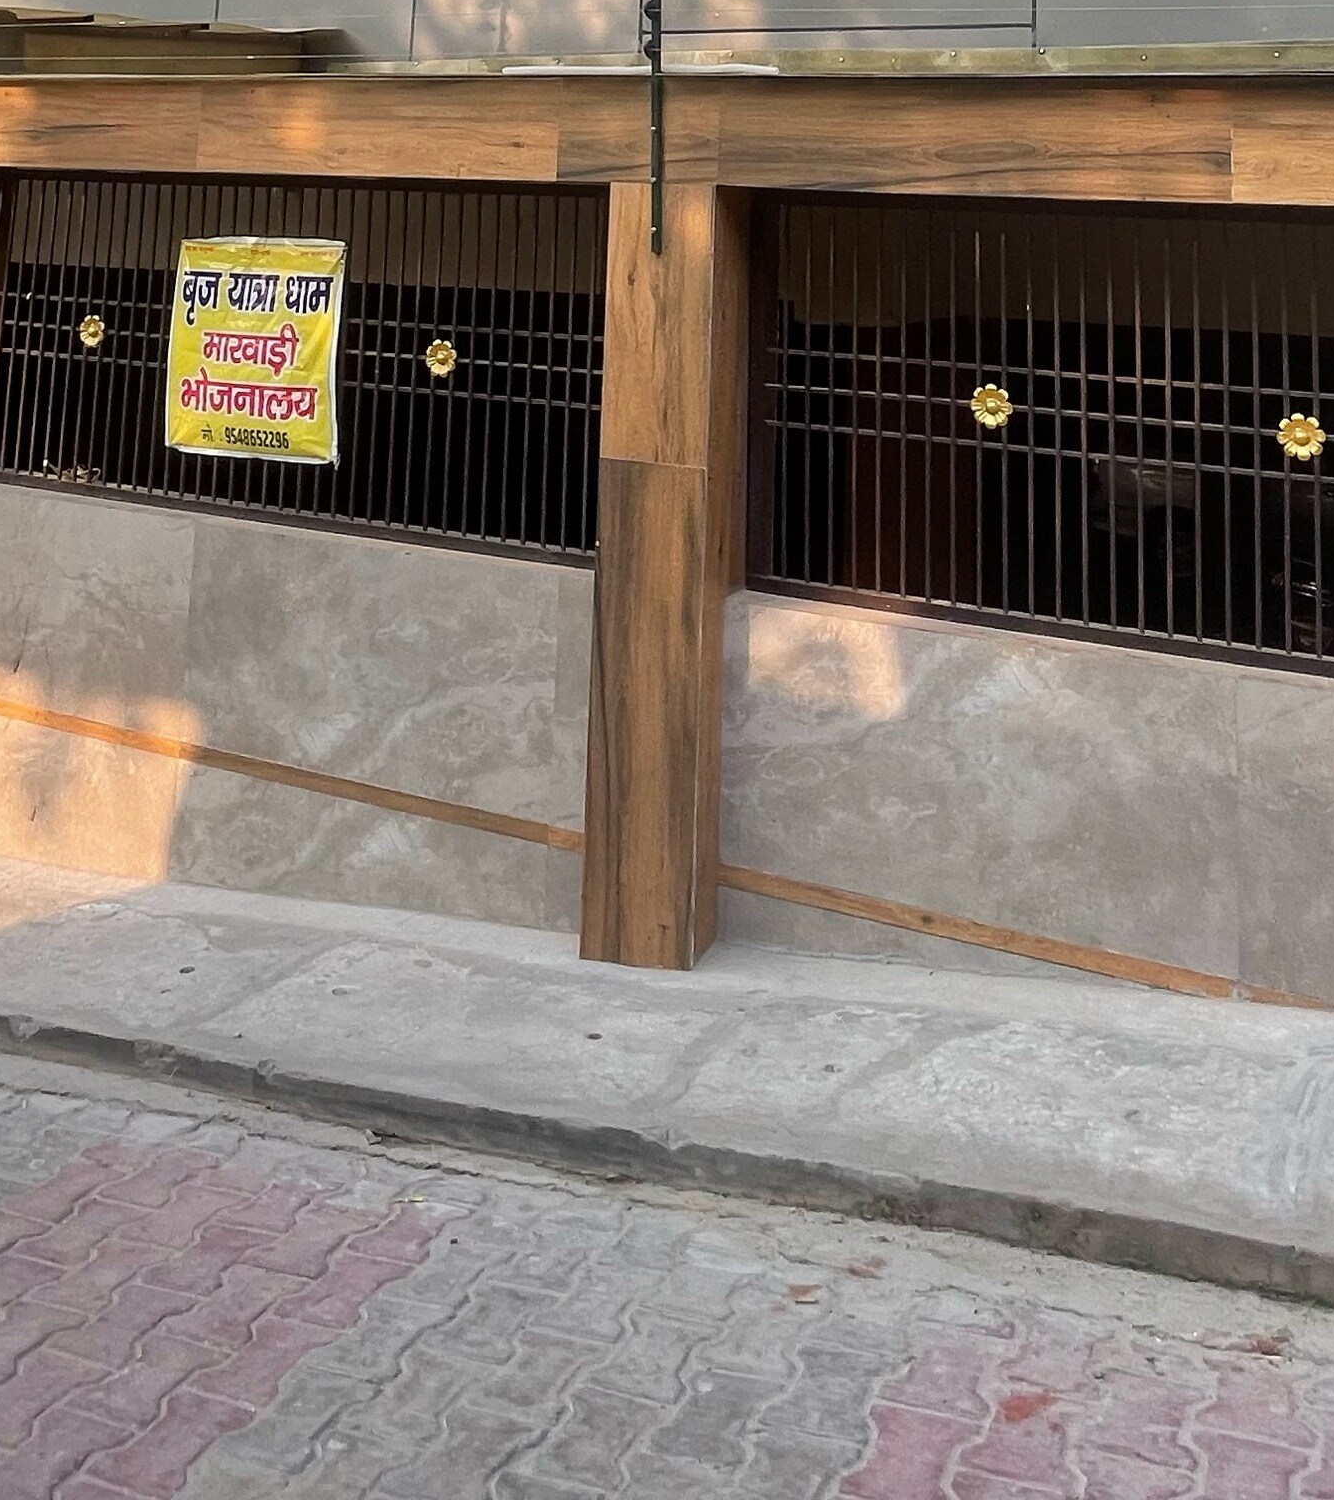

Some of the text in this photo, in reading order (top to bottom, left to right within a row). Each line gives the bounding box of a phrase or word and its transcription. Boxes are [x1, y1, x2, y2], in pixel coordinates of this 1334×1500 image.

[182, 270, 334, 326] बृज यात्रा धाम
[203, 323, 300, 377] मारवाड़ी
[181, 366, 318, 421] भोजनालय
[224, 426, 290, 450] 9548652296
